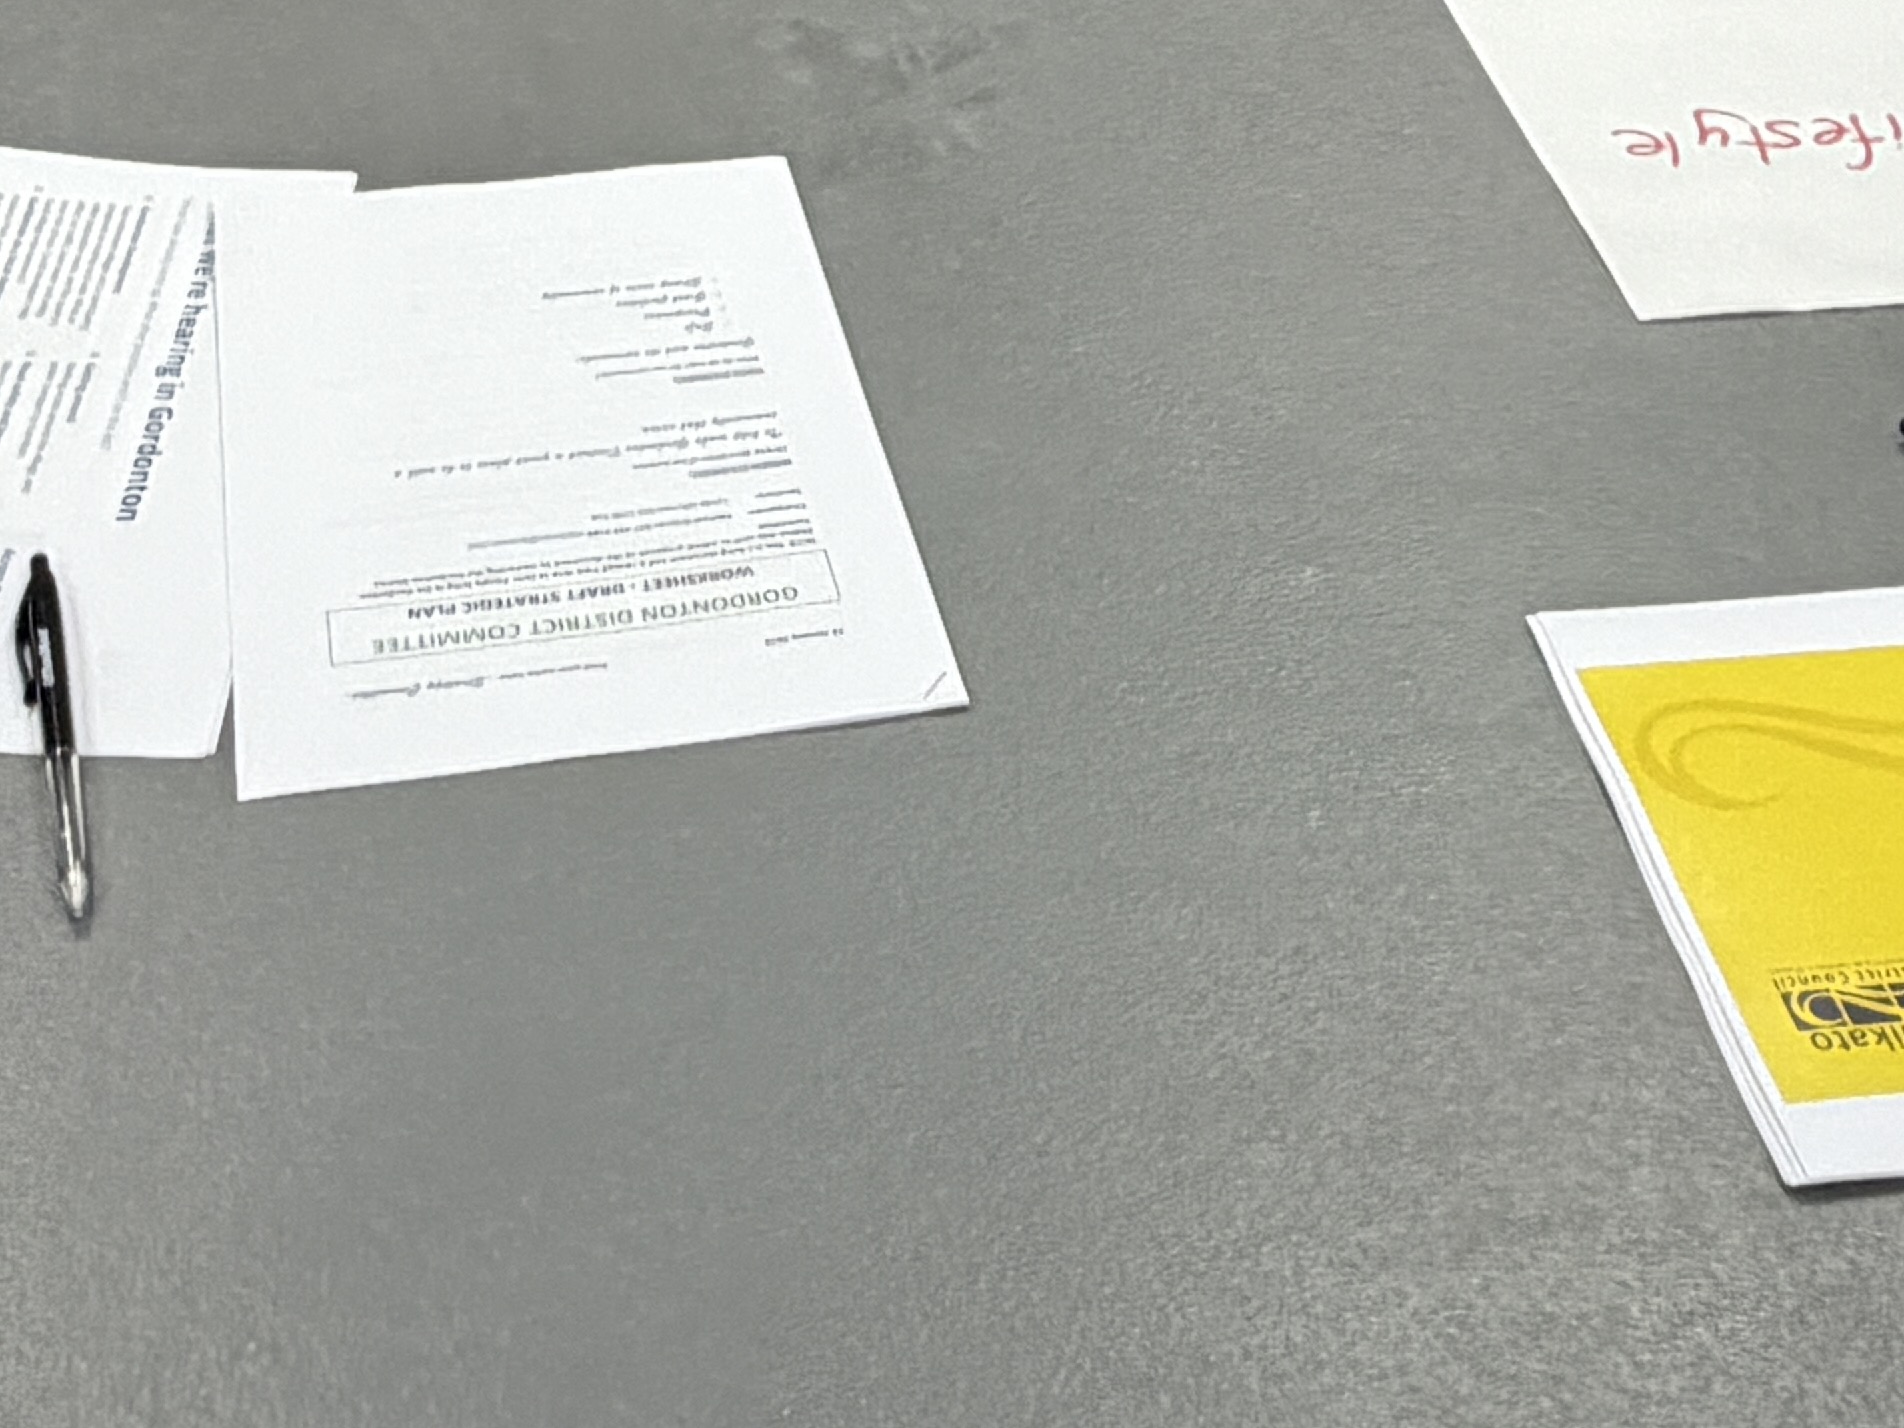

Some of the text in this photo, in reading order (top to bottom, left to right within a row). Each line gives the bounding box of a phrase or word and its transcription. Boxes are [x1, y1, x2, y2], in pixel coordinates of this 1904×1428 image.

[372, 584, 799, 655] GORDONTON DISTRICT COMMITTEE
